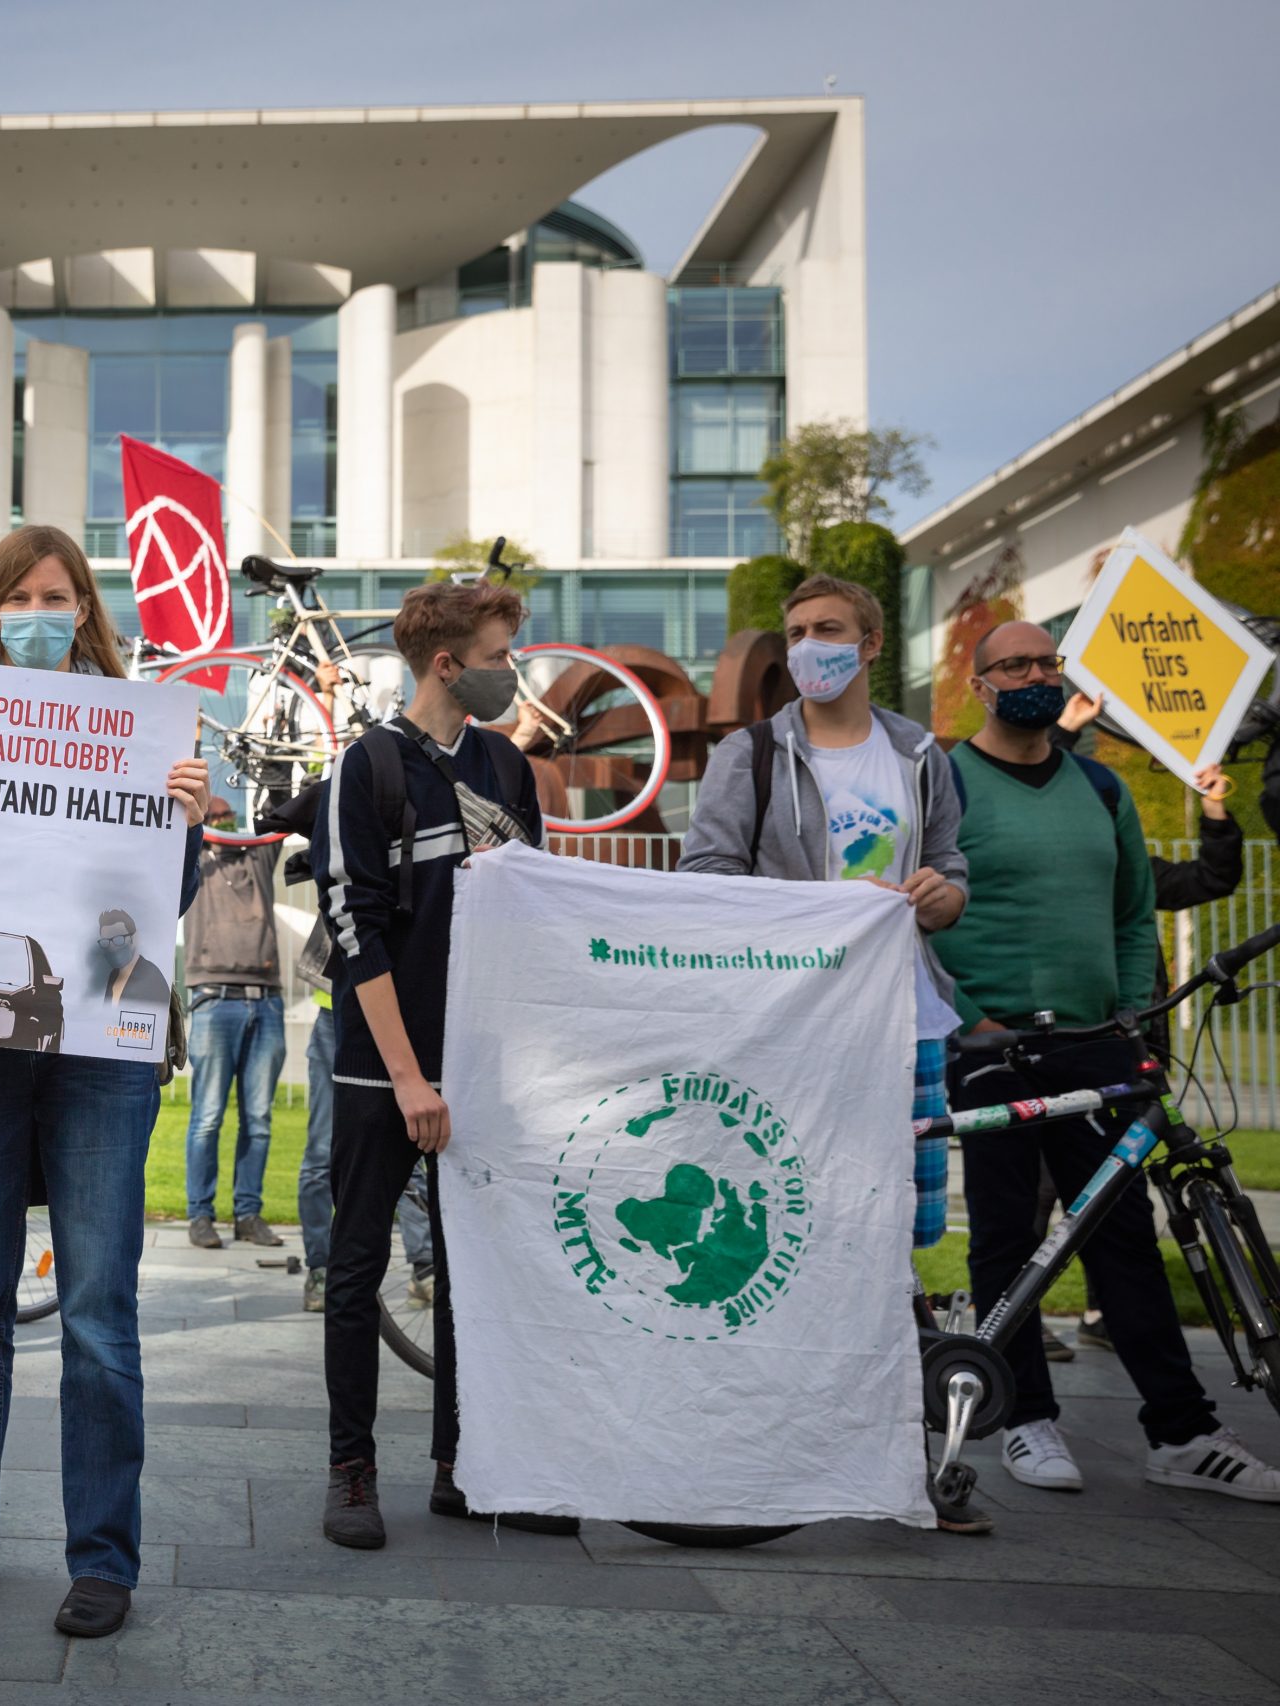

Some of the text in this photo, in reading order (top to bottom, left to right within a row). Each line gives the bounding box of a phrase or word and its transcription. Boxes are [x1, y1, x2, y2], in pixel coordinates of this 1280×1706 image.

[1110, 612, 1203, 643] Vorfahrt
[1141, 648, 1189, 677] fürs
[1142, 682, 1206, 713] Klima
[87, 707, 135, 738] UND
[65, 786, 174, 830] HALTEN!
[106, 1026, 150, 1040] CONTROL
[121, 1020, 153, 1034] LOBBY
[662, 1077, 806, 1327] FRIDAYS FOR FUTURE
[558, 1191, 616, 1295] MITTE
